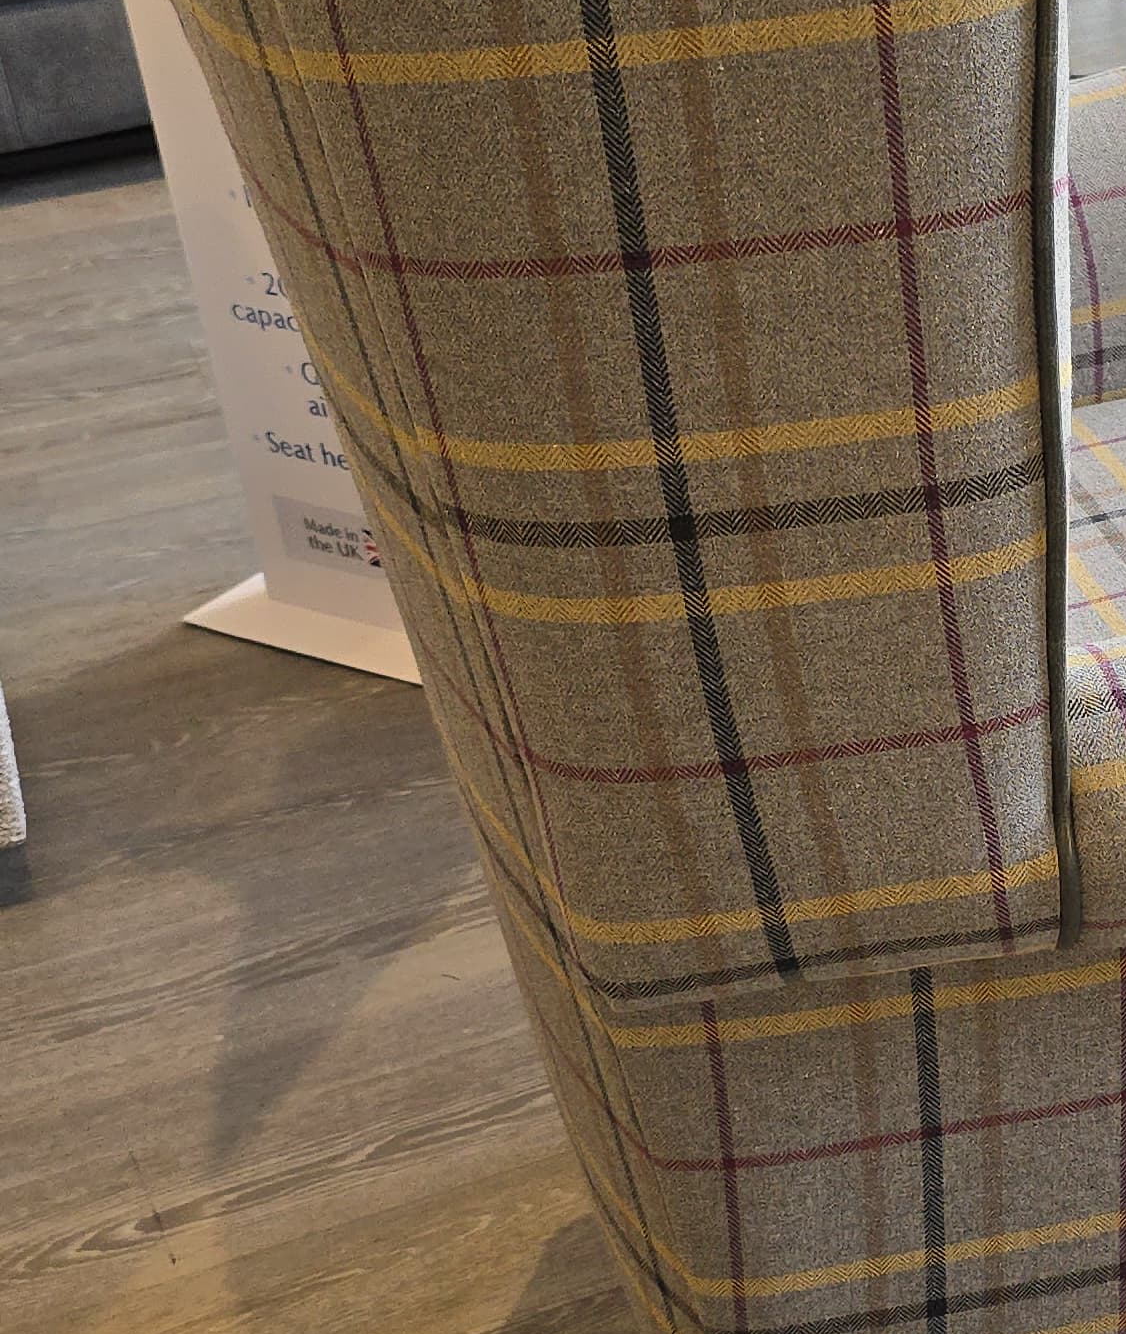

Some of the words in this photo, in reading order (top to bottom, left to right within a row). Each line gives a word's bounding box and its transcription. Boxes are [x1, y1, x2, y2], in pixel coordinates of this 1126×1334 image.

[232, 304, 301, 331] capac
[265, 431, 316, 463] Seat
[303, 517, 343, 539] Made
[344, 525, 360, 543] in
[307, 534, 334, 555] the
[337, 543, 365, 561] UK
